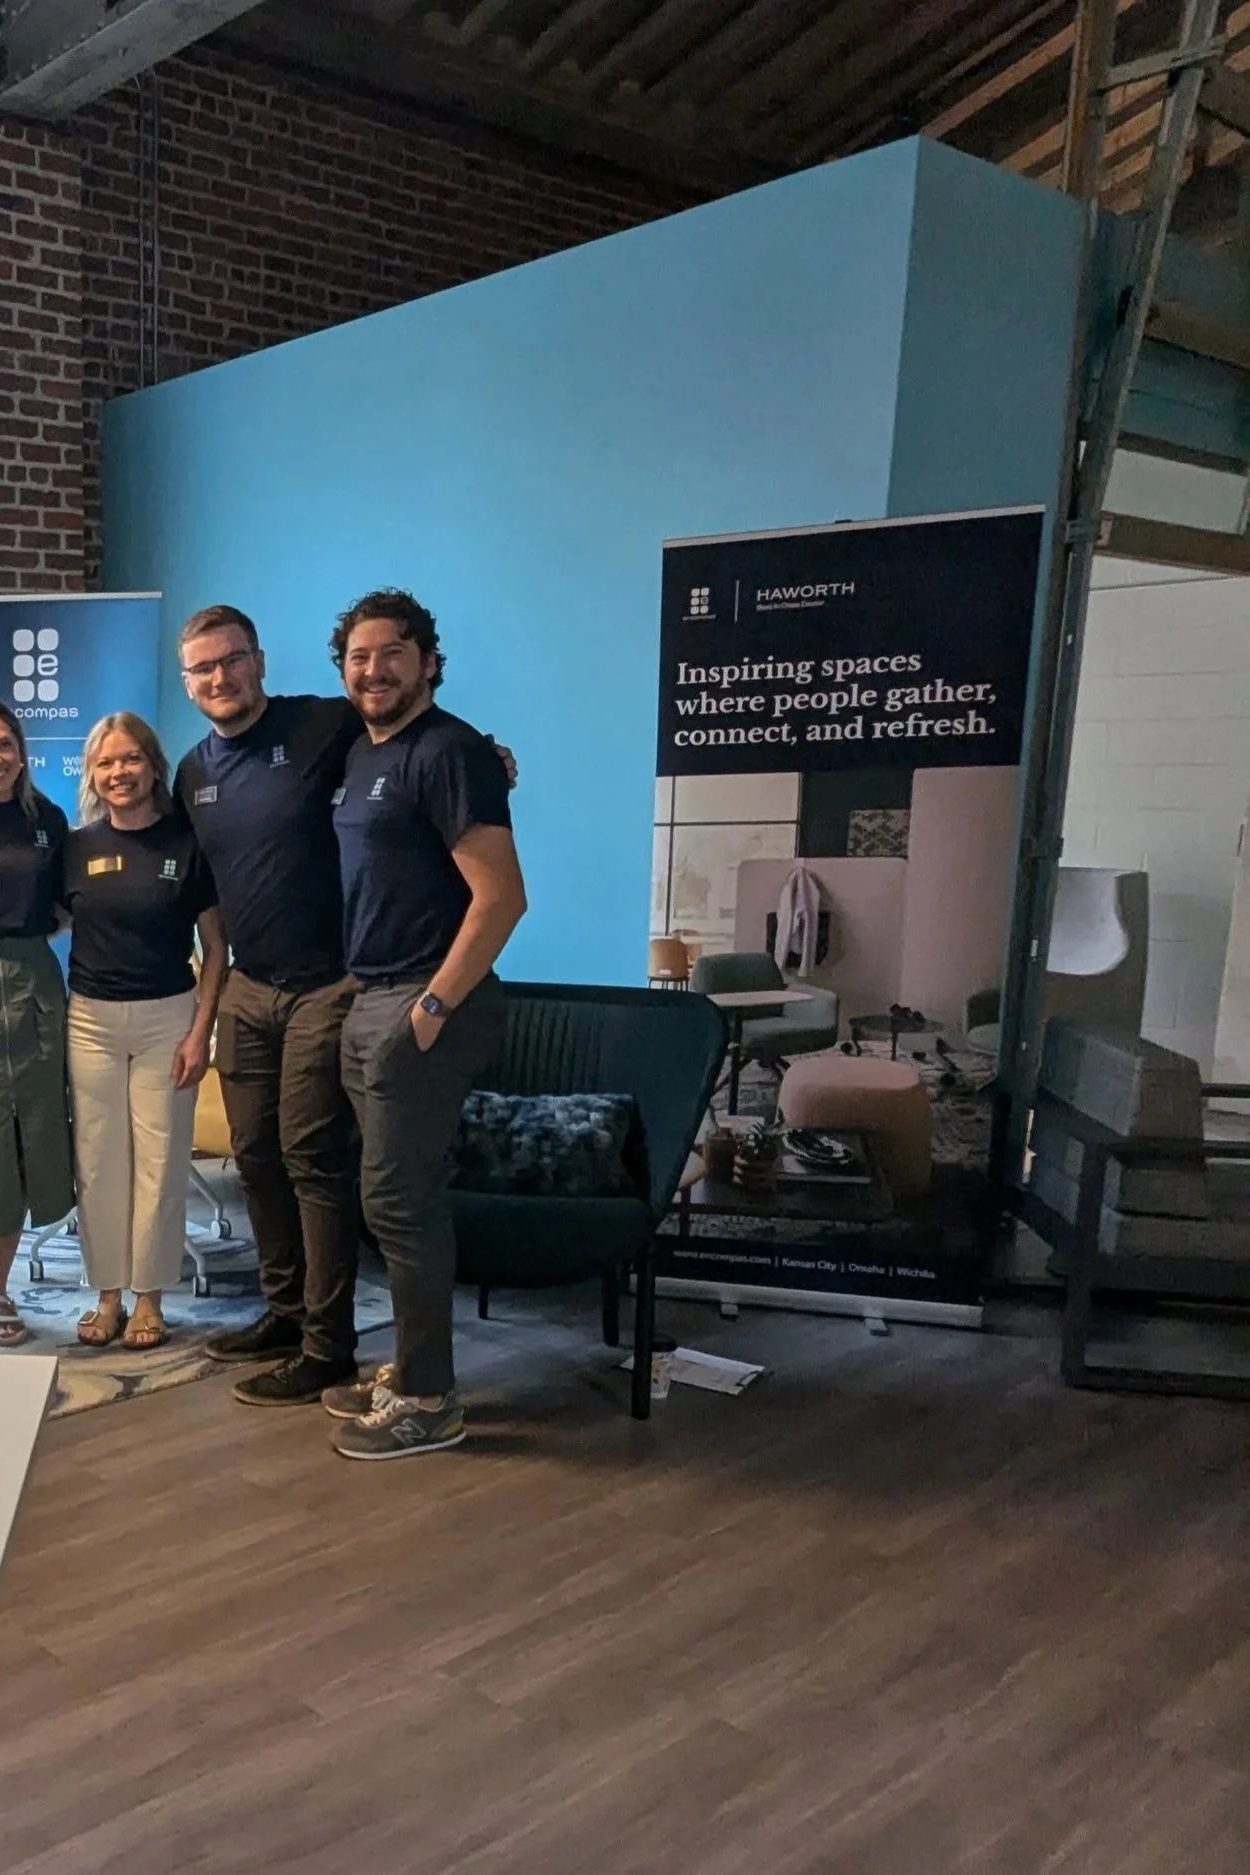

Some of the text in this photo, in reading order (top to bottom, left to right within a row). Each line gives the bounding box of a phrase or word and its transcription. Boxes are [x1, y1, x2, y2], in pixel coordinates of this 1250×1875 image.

[756, 582, 855, 602] HAWORTH
[676, 653, 922, 688] Inspiring spaces
[675, 678, 997, 717] where people gather,
[14, 707, 79, 721] compas
[674, 710, 996, 747] connect, and refresh.
[817, 1260, 837, 1273] City
